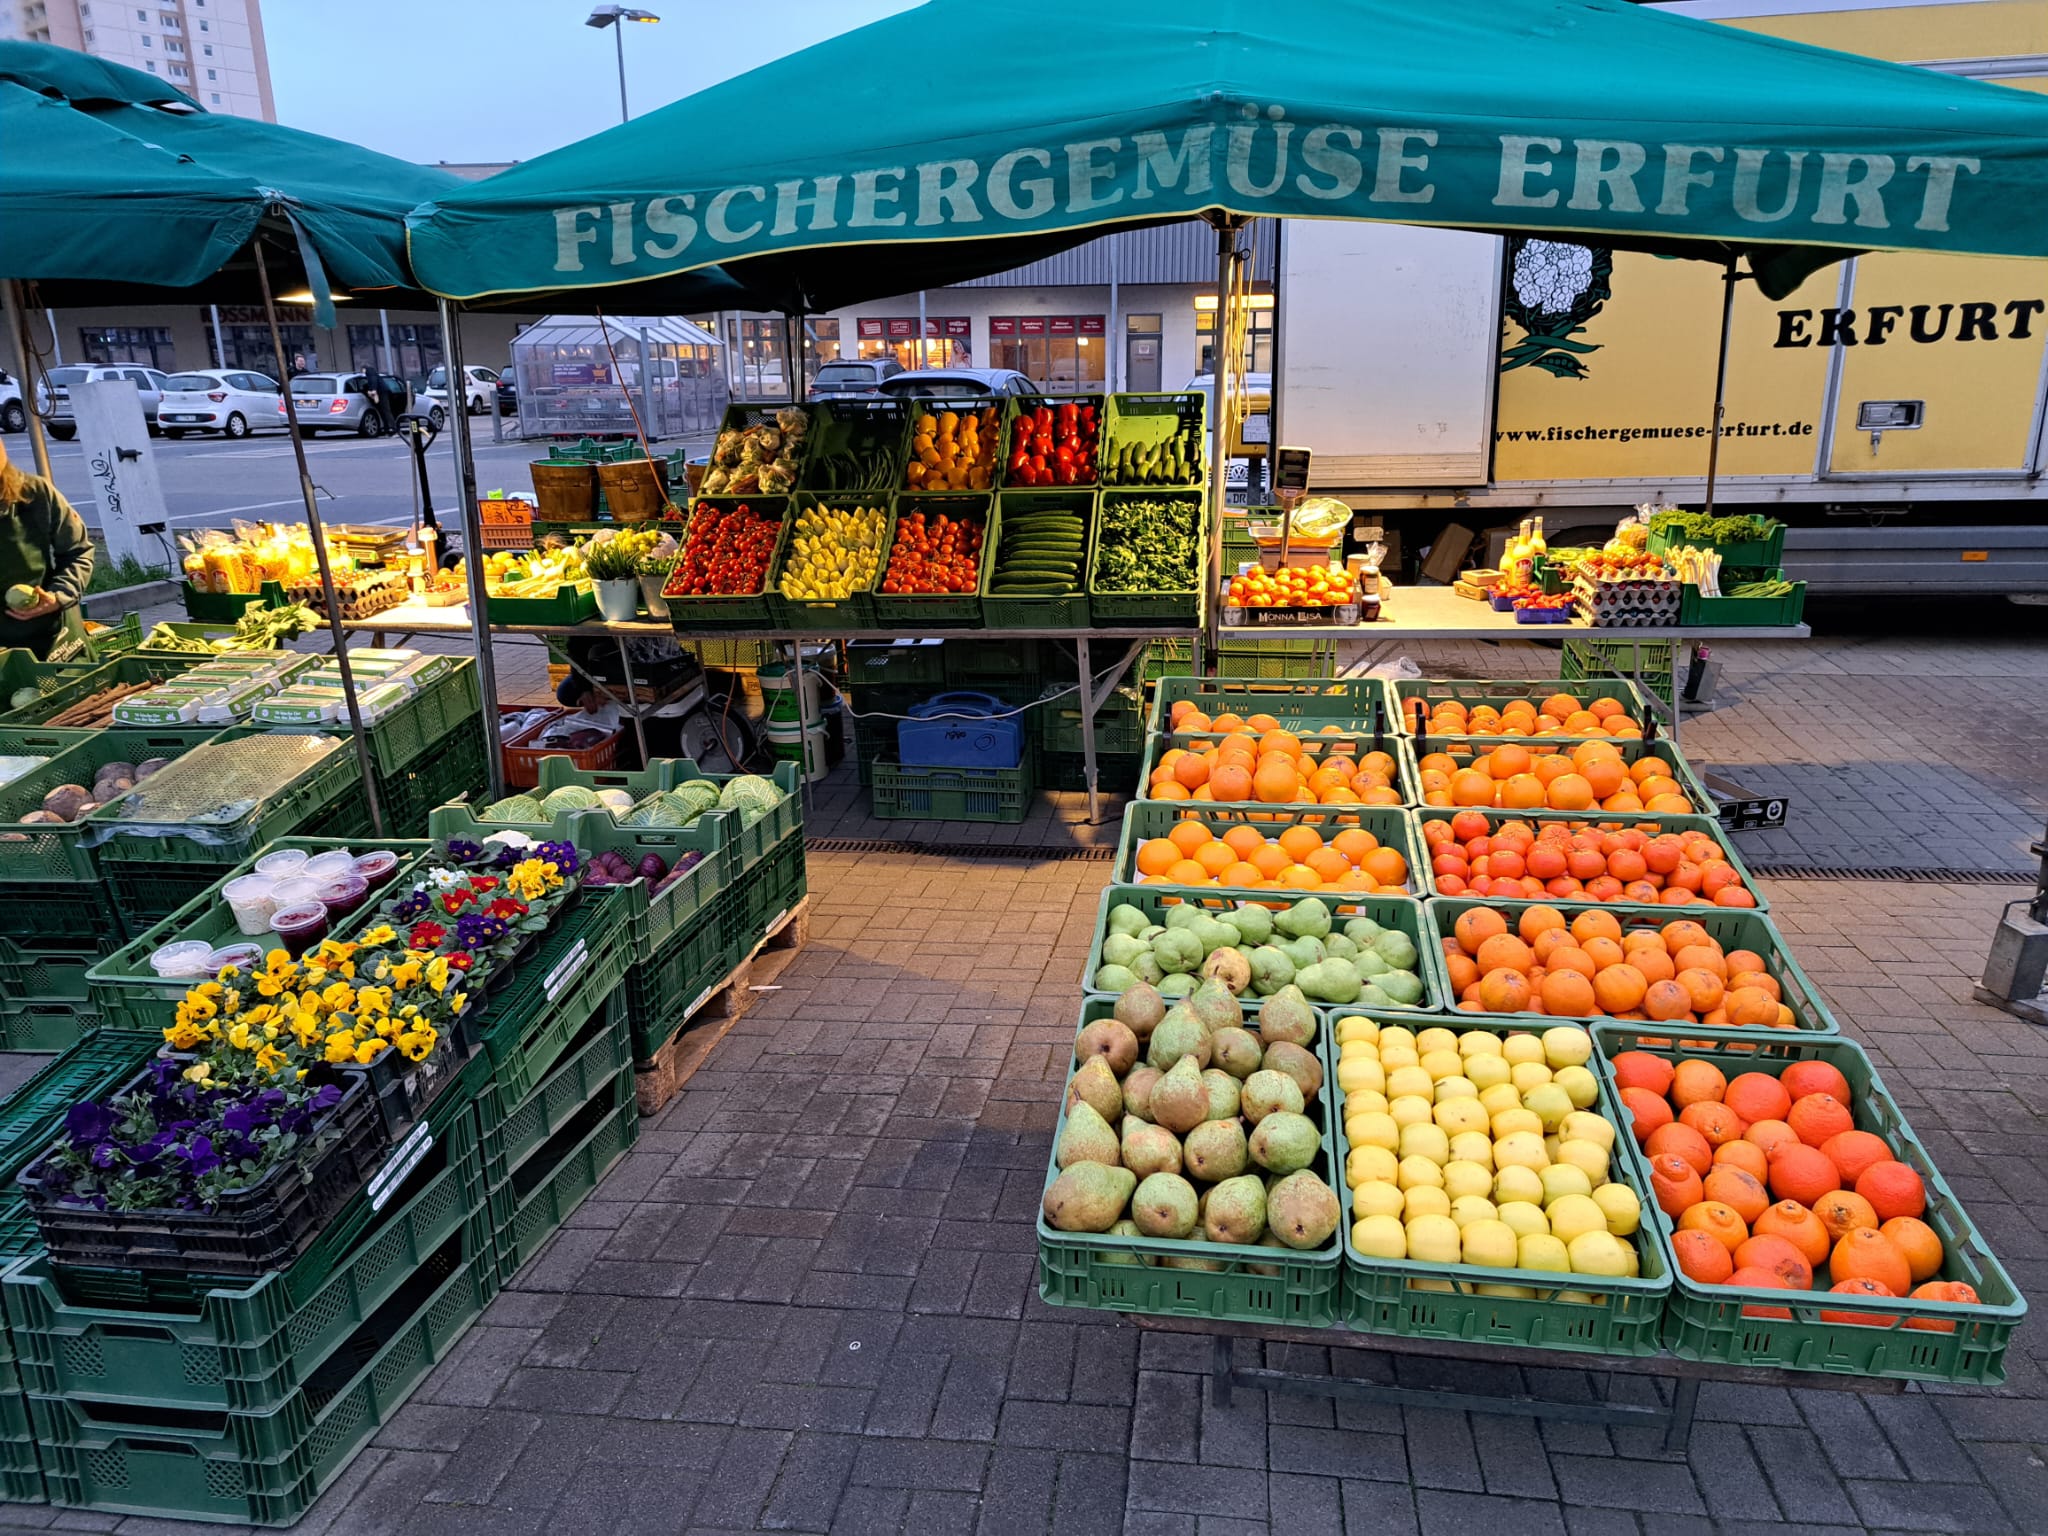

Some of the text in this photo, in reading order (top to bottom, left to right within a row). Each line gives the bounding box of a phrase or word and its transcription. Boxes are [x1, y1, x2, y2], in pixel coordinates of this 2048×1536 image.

[553, 103, 1982, 272] FISCHERGEMÜSE ERFURT
[1773, 299, 2046, 349] ERFURT
[1258, 611, 1322, 622] MONNA LISA
